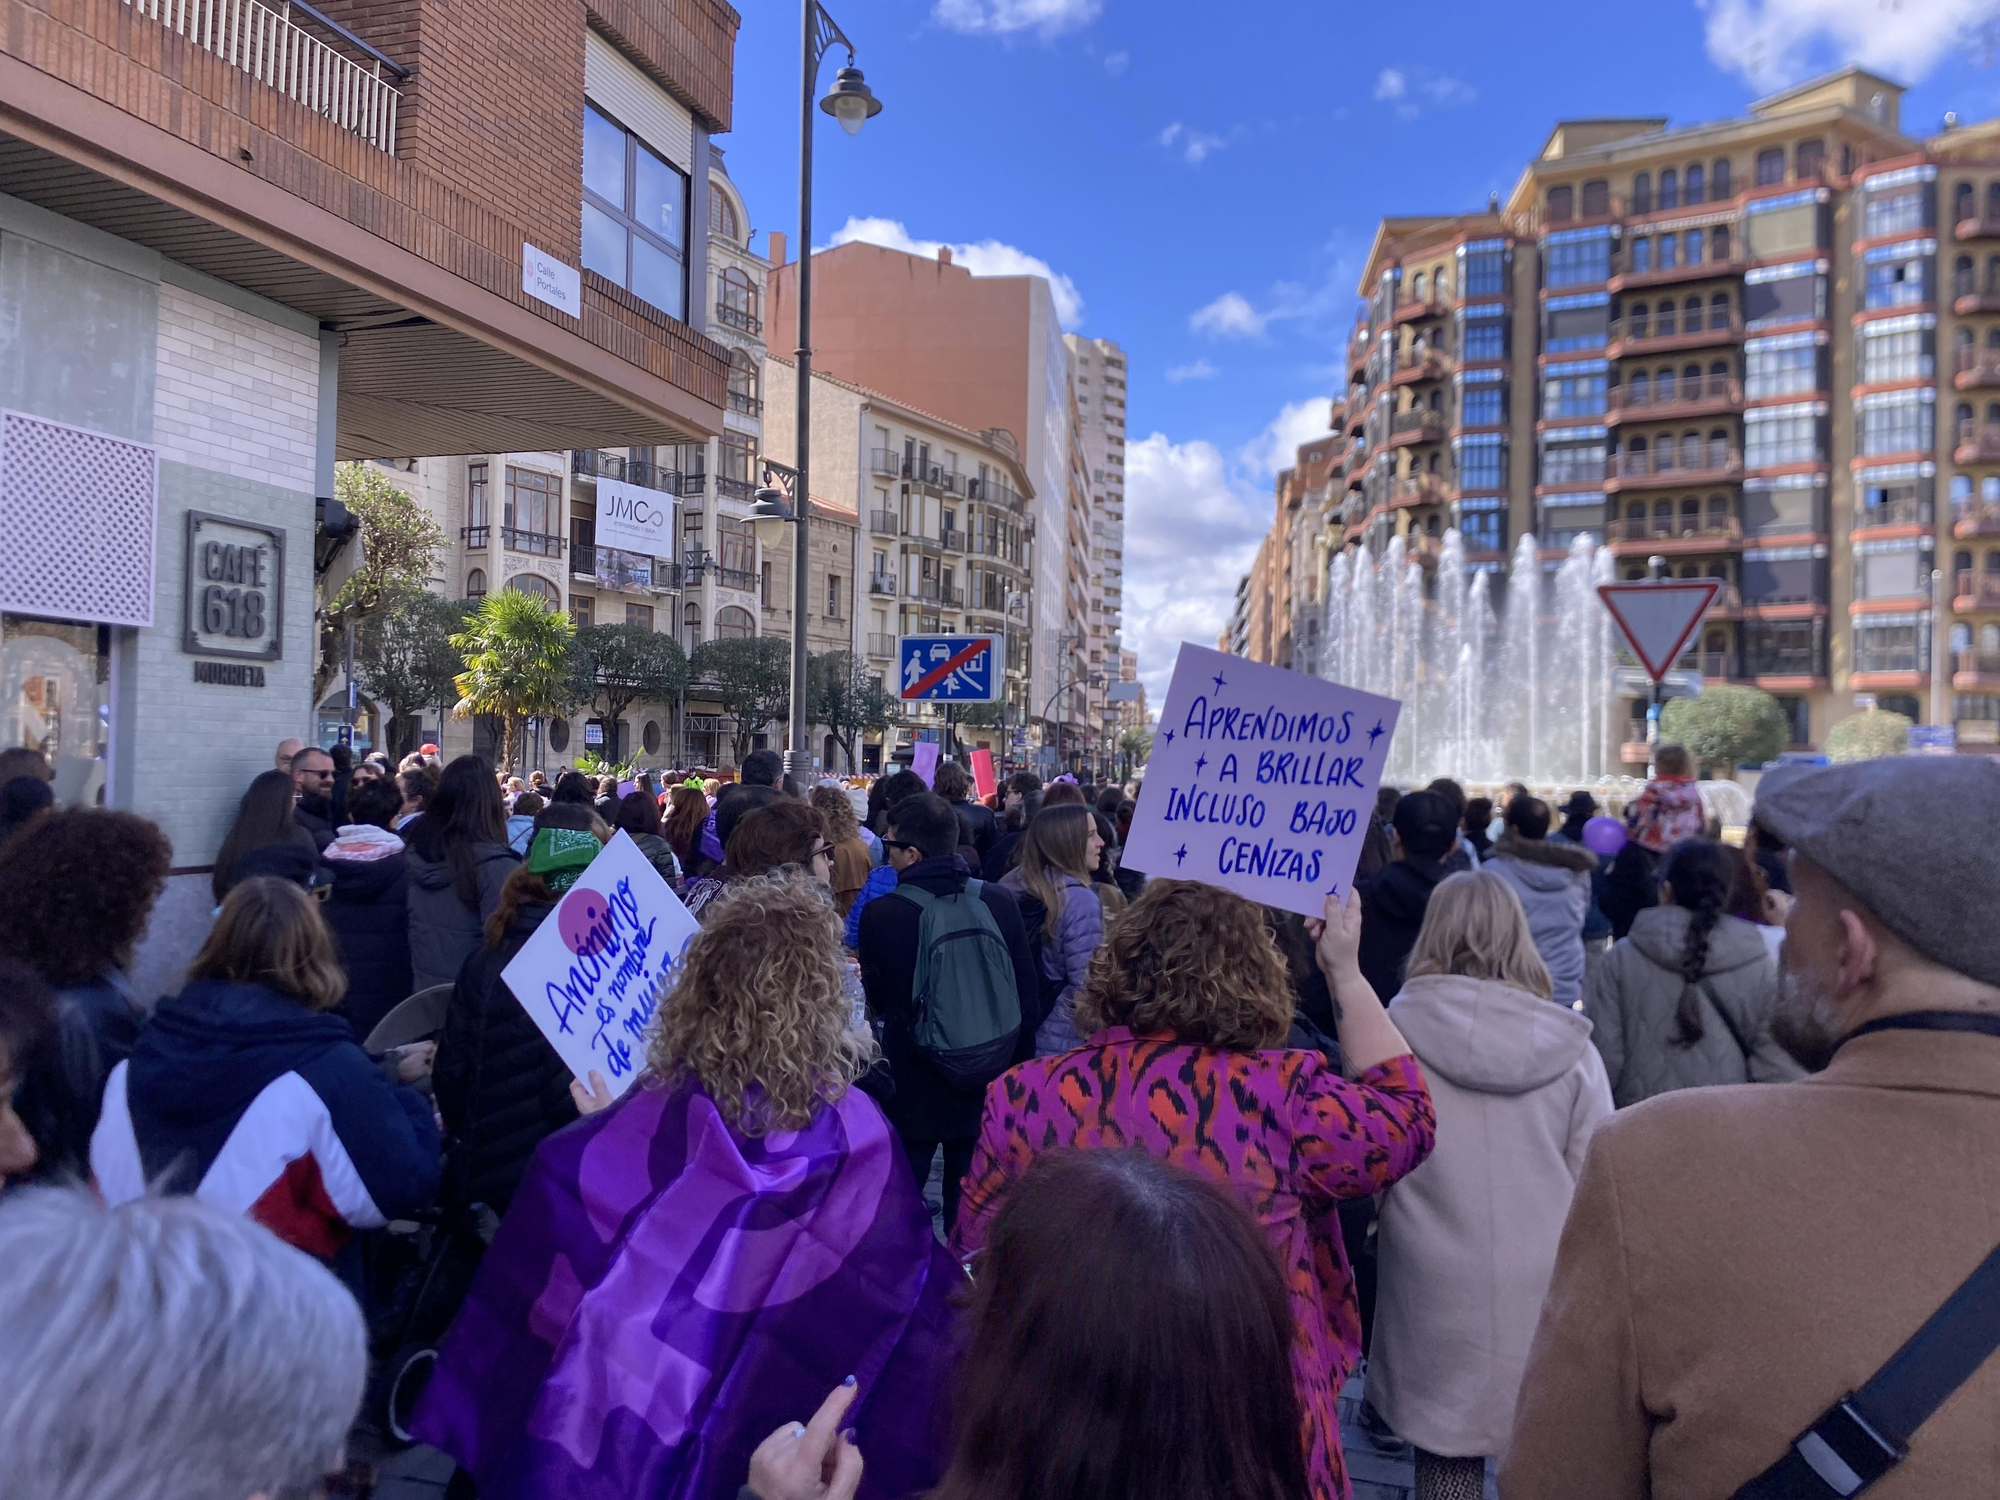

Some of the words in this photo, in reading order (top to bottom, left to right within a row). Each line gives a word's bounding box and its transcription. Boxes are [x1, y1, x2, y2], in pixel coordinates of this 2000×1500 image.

[537, 262, 555, 280] Calle
[537, 277, 566, 300] Portales
[205, 541, 268, 587] CAFÉ
[205, 584, 266, 638] 618
[194, 660, 266, 688] MURRIETA
[1184, 696, 1354, 744] APRENDIMOS
[1219, 753, 1237, 783] A
[1256, 750, 1365, 788] BRILLAR
[1164, 784, 1266, 828] INCLUSO
[1289, 800, 1357, 836] BAJO
[1219, 836, 1323, 883] CENIZAS
[546, 875, 640, 1036] Anónimo
[608, 916, 657, 1002] nombre
[600, 1032, 633, 1078] de
